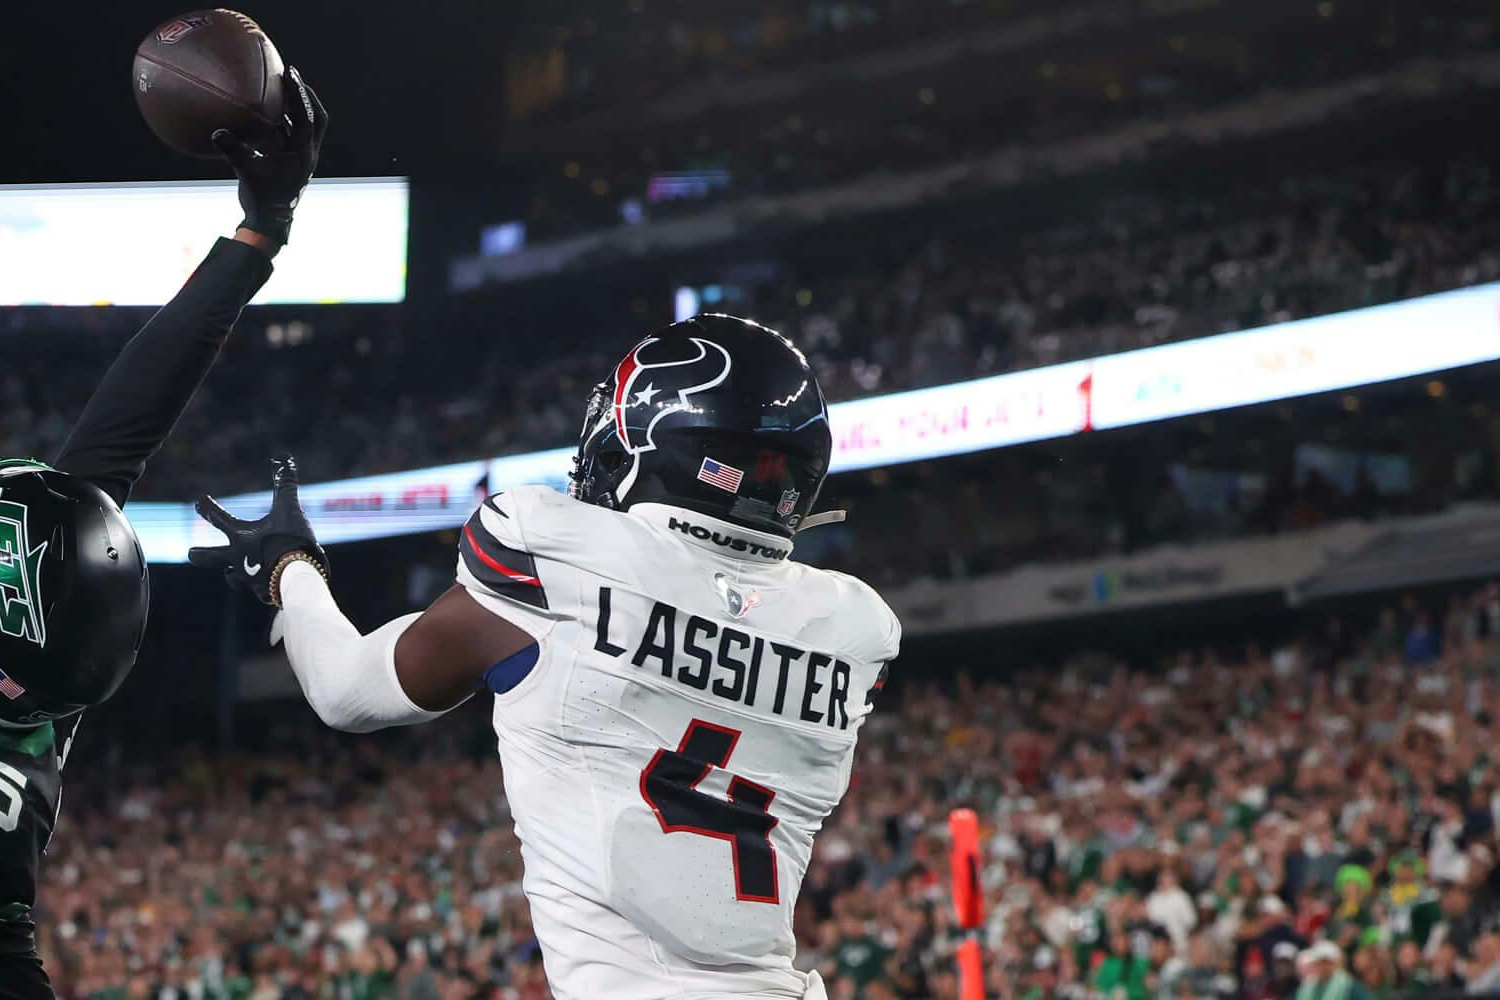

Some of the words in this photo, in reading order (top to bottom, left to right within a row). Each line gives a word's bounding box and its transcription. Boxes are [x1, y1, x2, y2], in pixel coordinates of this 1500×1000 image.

[668, 517, 789, 561] HOUSTON
[594, 586, 851, 730] LASSITER
[639, 718, 780, 905] 4
